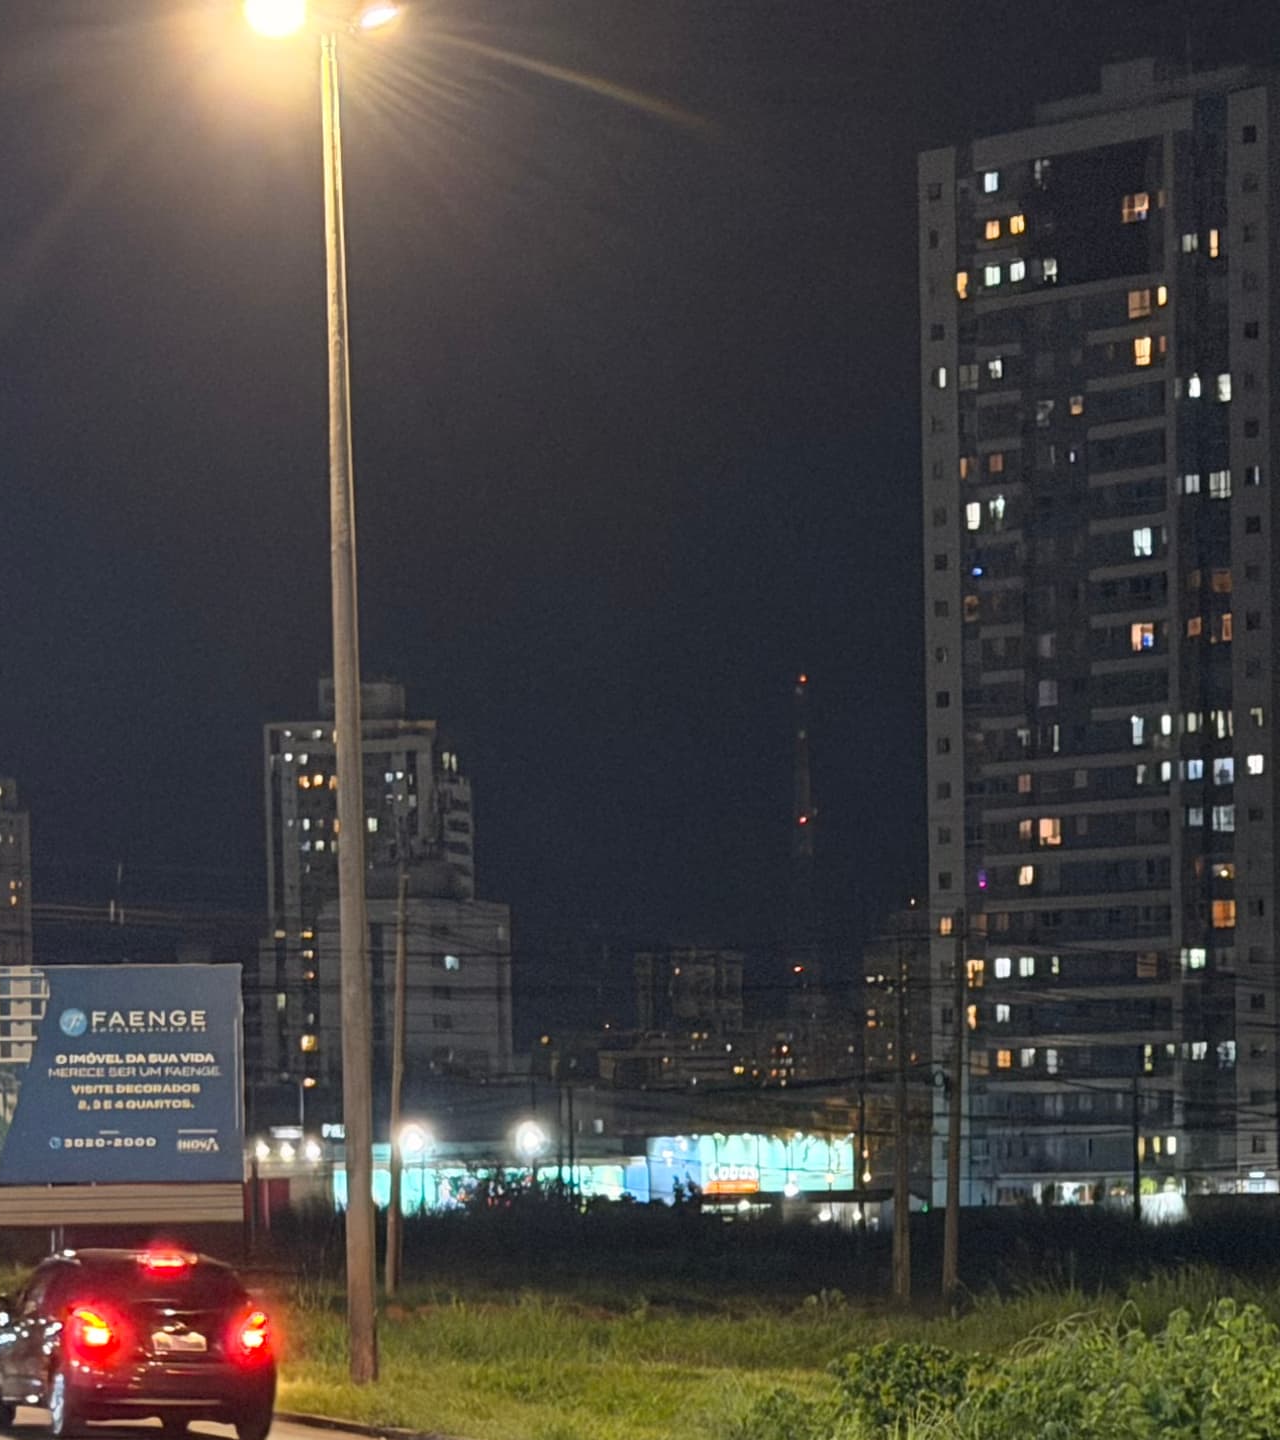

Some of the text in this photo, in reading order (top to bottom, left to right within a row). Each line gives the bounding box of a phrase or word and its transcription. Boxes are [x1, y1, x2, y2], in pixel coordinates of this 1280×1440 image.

[91, 1009, 207, 1027] FAENGE
[55, 1054, 68, 1065] O
[125, 1053, 146, 1064] DA
[148, 1053, 179, 1064] SUA
[180, 1052, 215, 1064] VIDA
[48, 1067, 105, 1078] MERECE
[108, 1066, 136, 1077] SER
[139, 1066, 162, 1077] UM
[71, 1083, 201, 1095] VISITE DECORADOS
